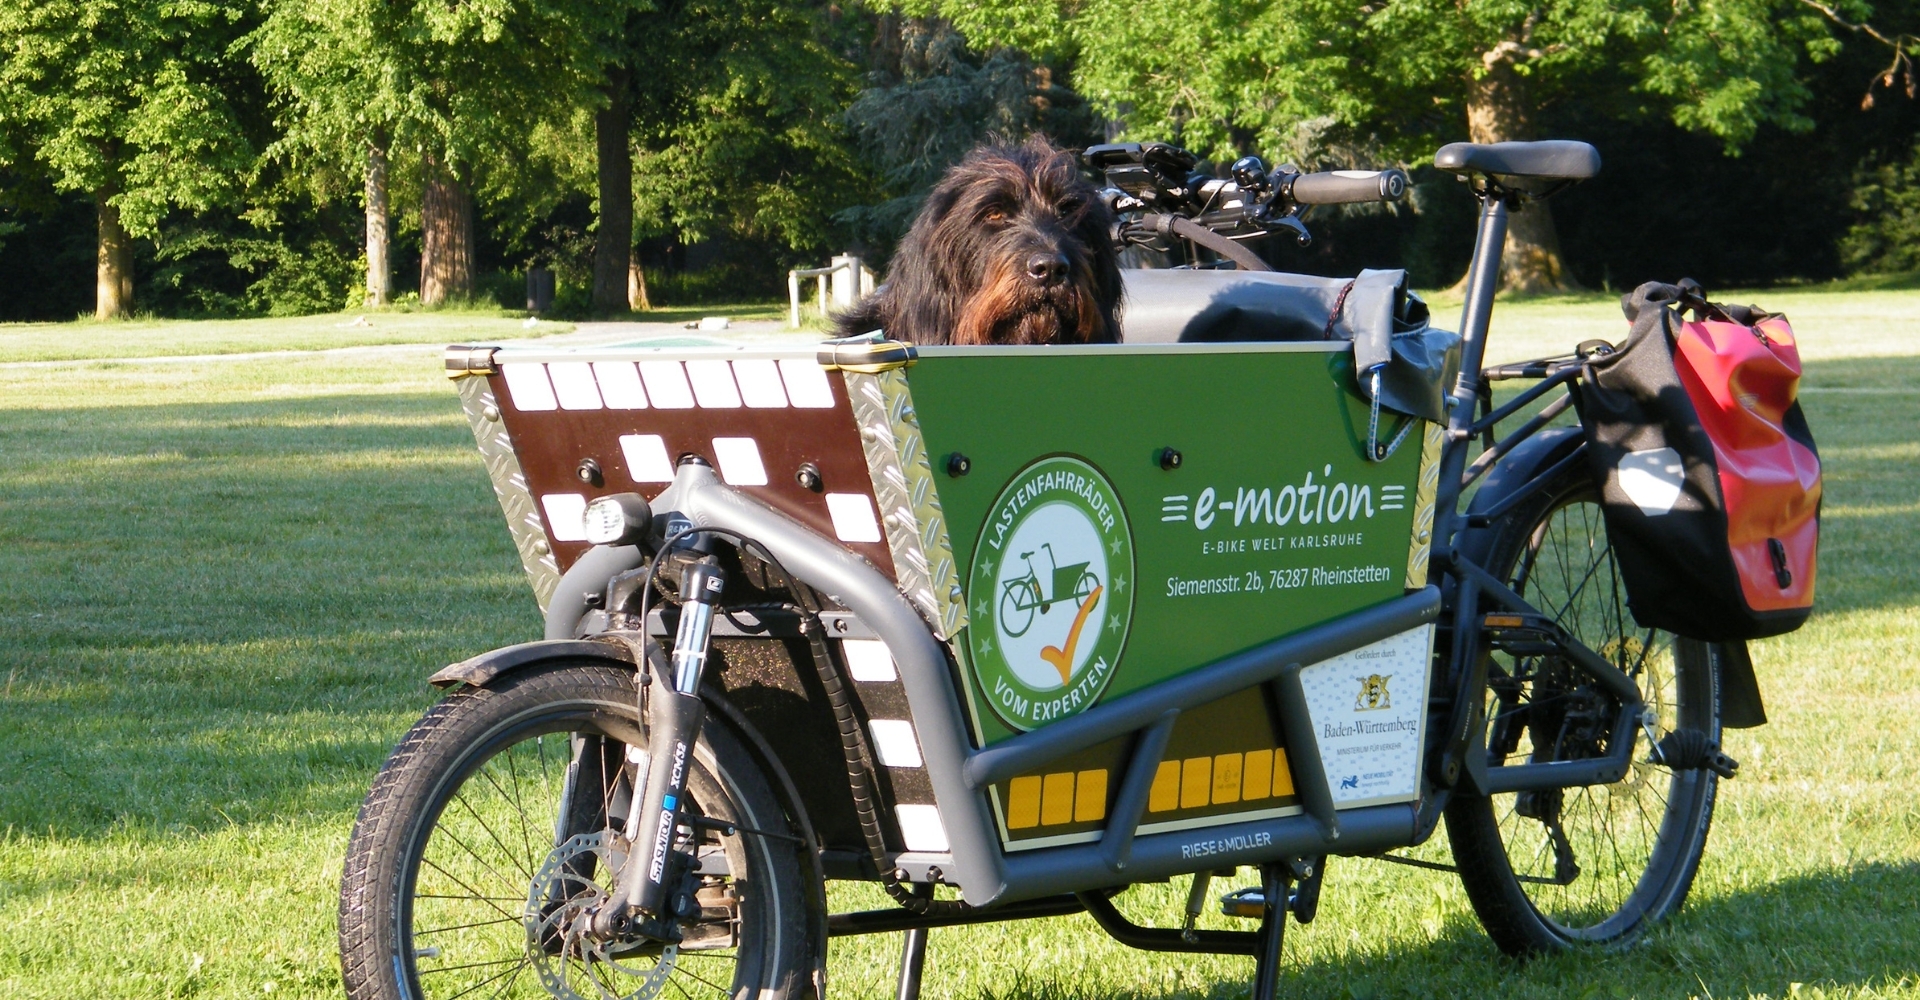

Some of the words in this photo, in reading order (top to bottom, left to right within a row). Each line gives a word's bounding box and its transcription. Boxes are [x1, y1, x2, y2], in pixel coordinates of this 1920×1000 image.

[988, 471, 1115, 551] LASTENFAHRRÄDER
[1194, 463, 1374, 531] e-motion
[1202, 538, 1246, 555] E-BIKE
[1252, 537, 1285, 551] WELT
[1290, 532, 1363, 549] KARLSRUHE
[1166, 574, 1241, 597] Siemensstr.
[1245, 571, 1265, 594] 2b,
[1269, 567, 1308, 589] 76287
[1311, 565, 1391, 587] Rheinstetten
[993, 675, 1028, 718] VOM
[1032, 655, 1109, 722] EXPERTEN
[1323, 716, 1417, 739] Baden-Württemberg
[670, 741, 687, 790] XCM32
